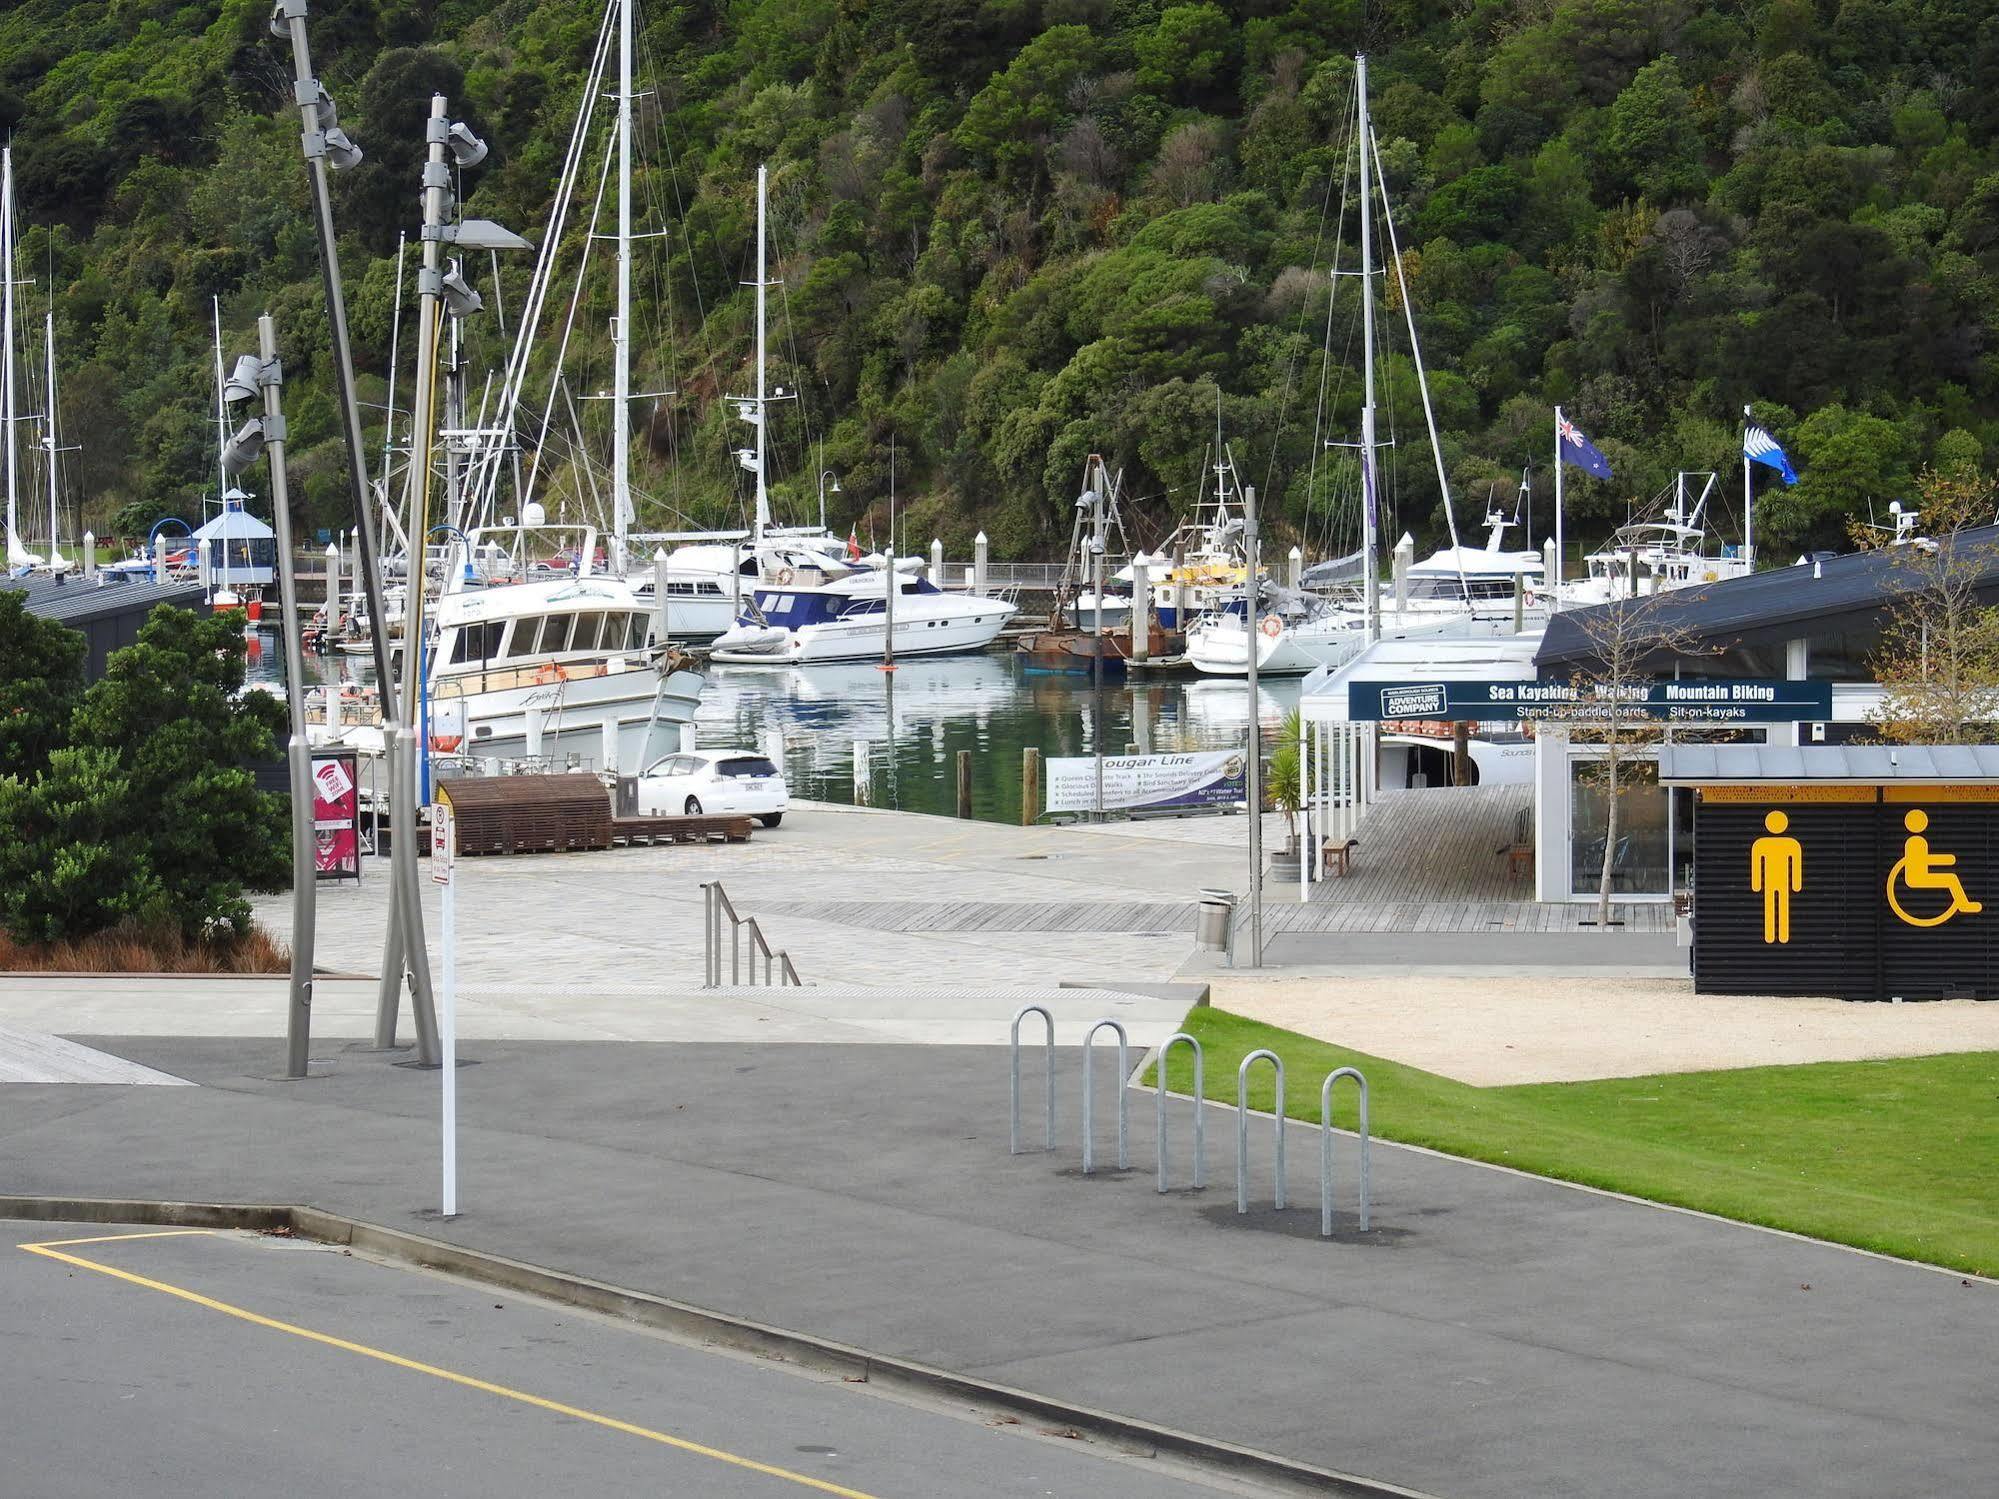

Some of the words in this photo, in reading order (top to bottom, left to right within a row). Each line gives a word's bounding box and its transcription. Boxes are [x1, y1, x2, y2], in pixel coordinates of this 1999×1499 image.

[1489, 685, 1514, 700] Sea
[1517, 685, 1578, 702] Kayaking
[1666, 685, 1728, 700] Mountain
[1733, 685, 1775, 702] Biking
[1388, 695, 1440, 706] ADVENTURE
[1388, 702, 1440, 715] COMPANY
[1669, 706, 1746, 719] Sit-on-kayaks
[1095, 758, 1156, 770] ougar
[1161, 755, 1194, 766] Line
